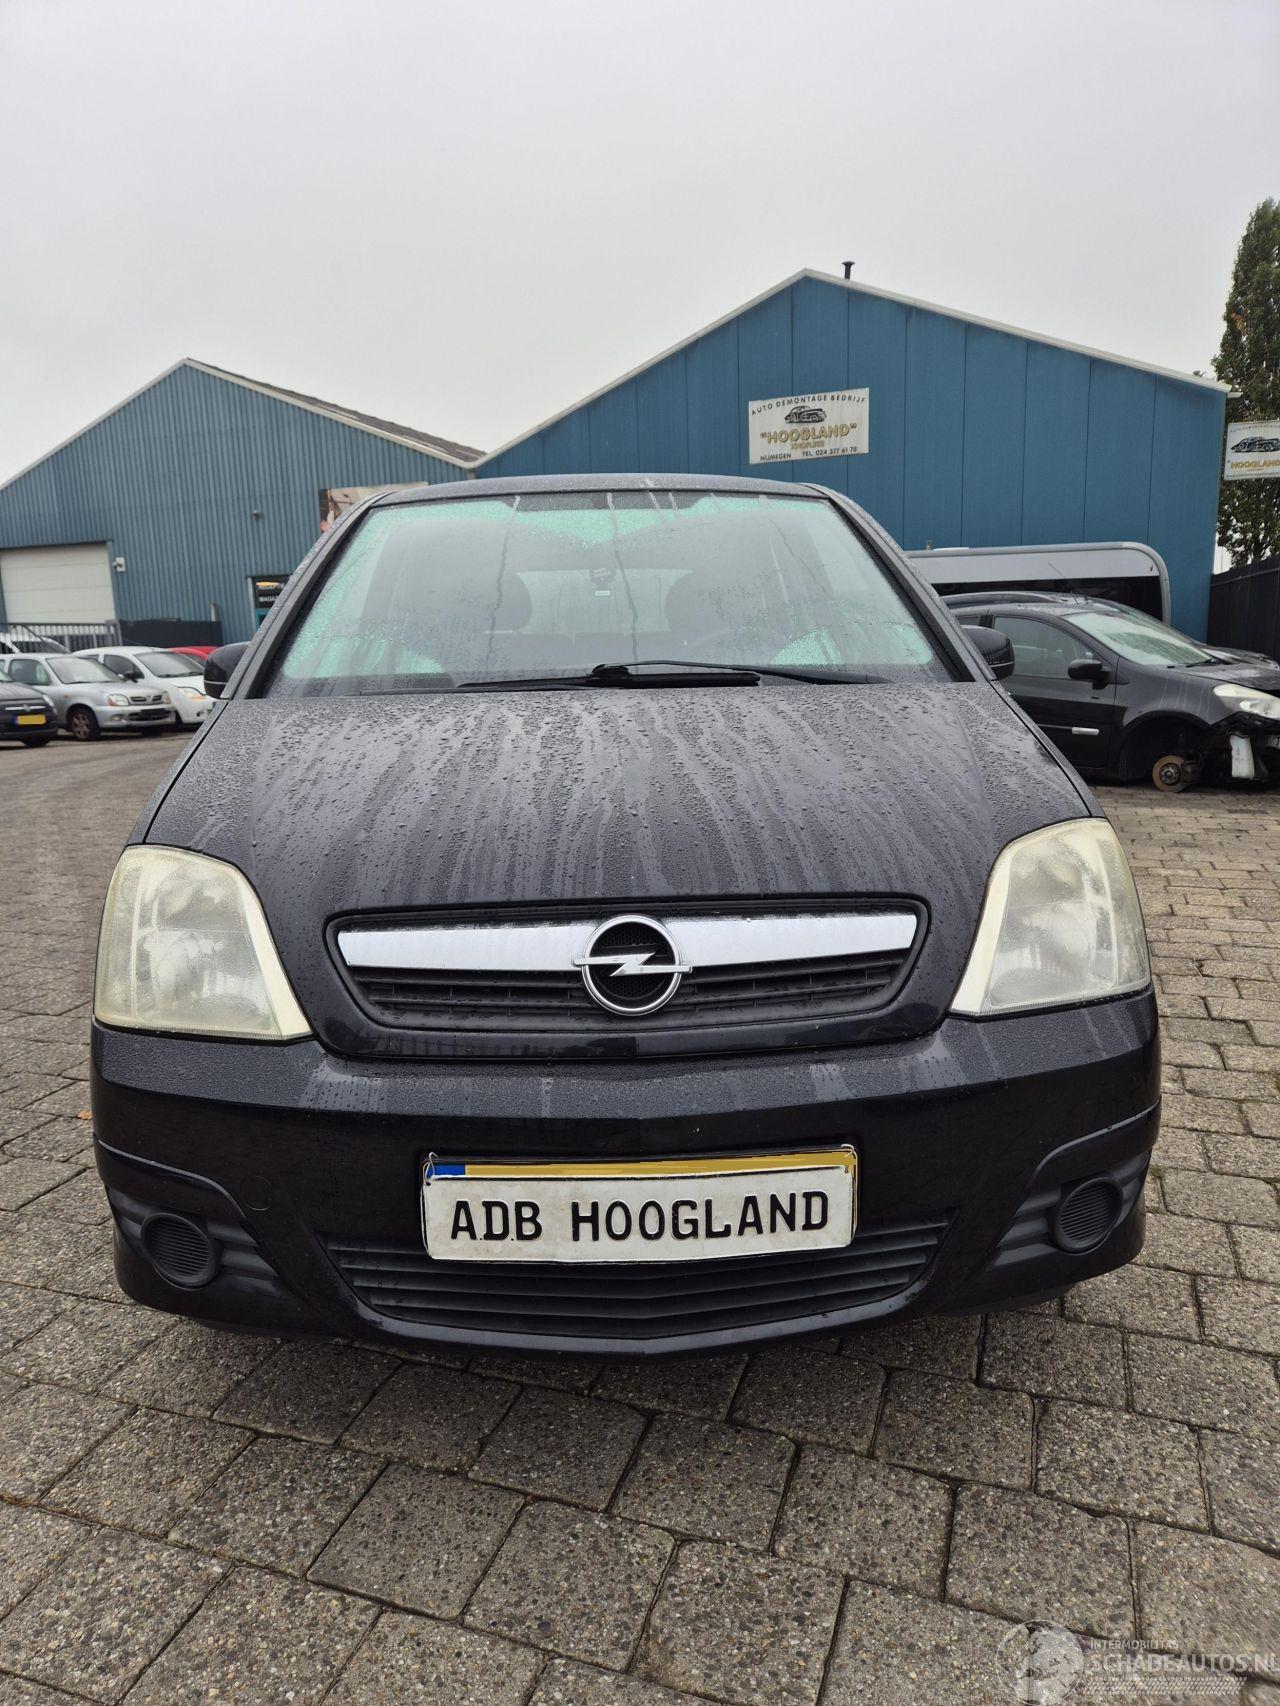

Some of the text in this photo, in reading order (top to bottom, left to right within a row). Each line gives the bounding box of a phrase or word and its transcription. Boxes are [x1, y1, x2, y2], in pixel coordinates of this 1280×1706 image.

[752, 394, 866, 416] AUTO DEMONTAGE BEDRIJF
[760, 453, 792, 461] NIJMEGEN
[571, 1190, 829, 1241] HOOGLAND
